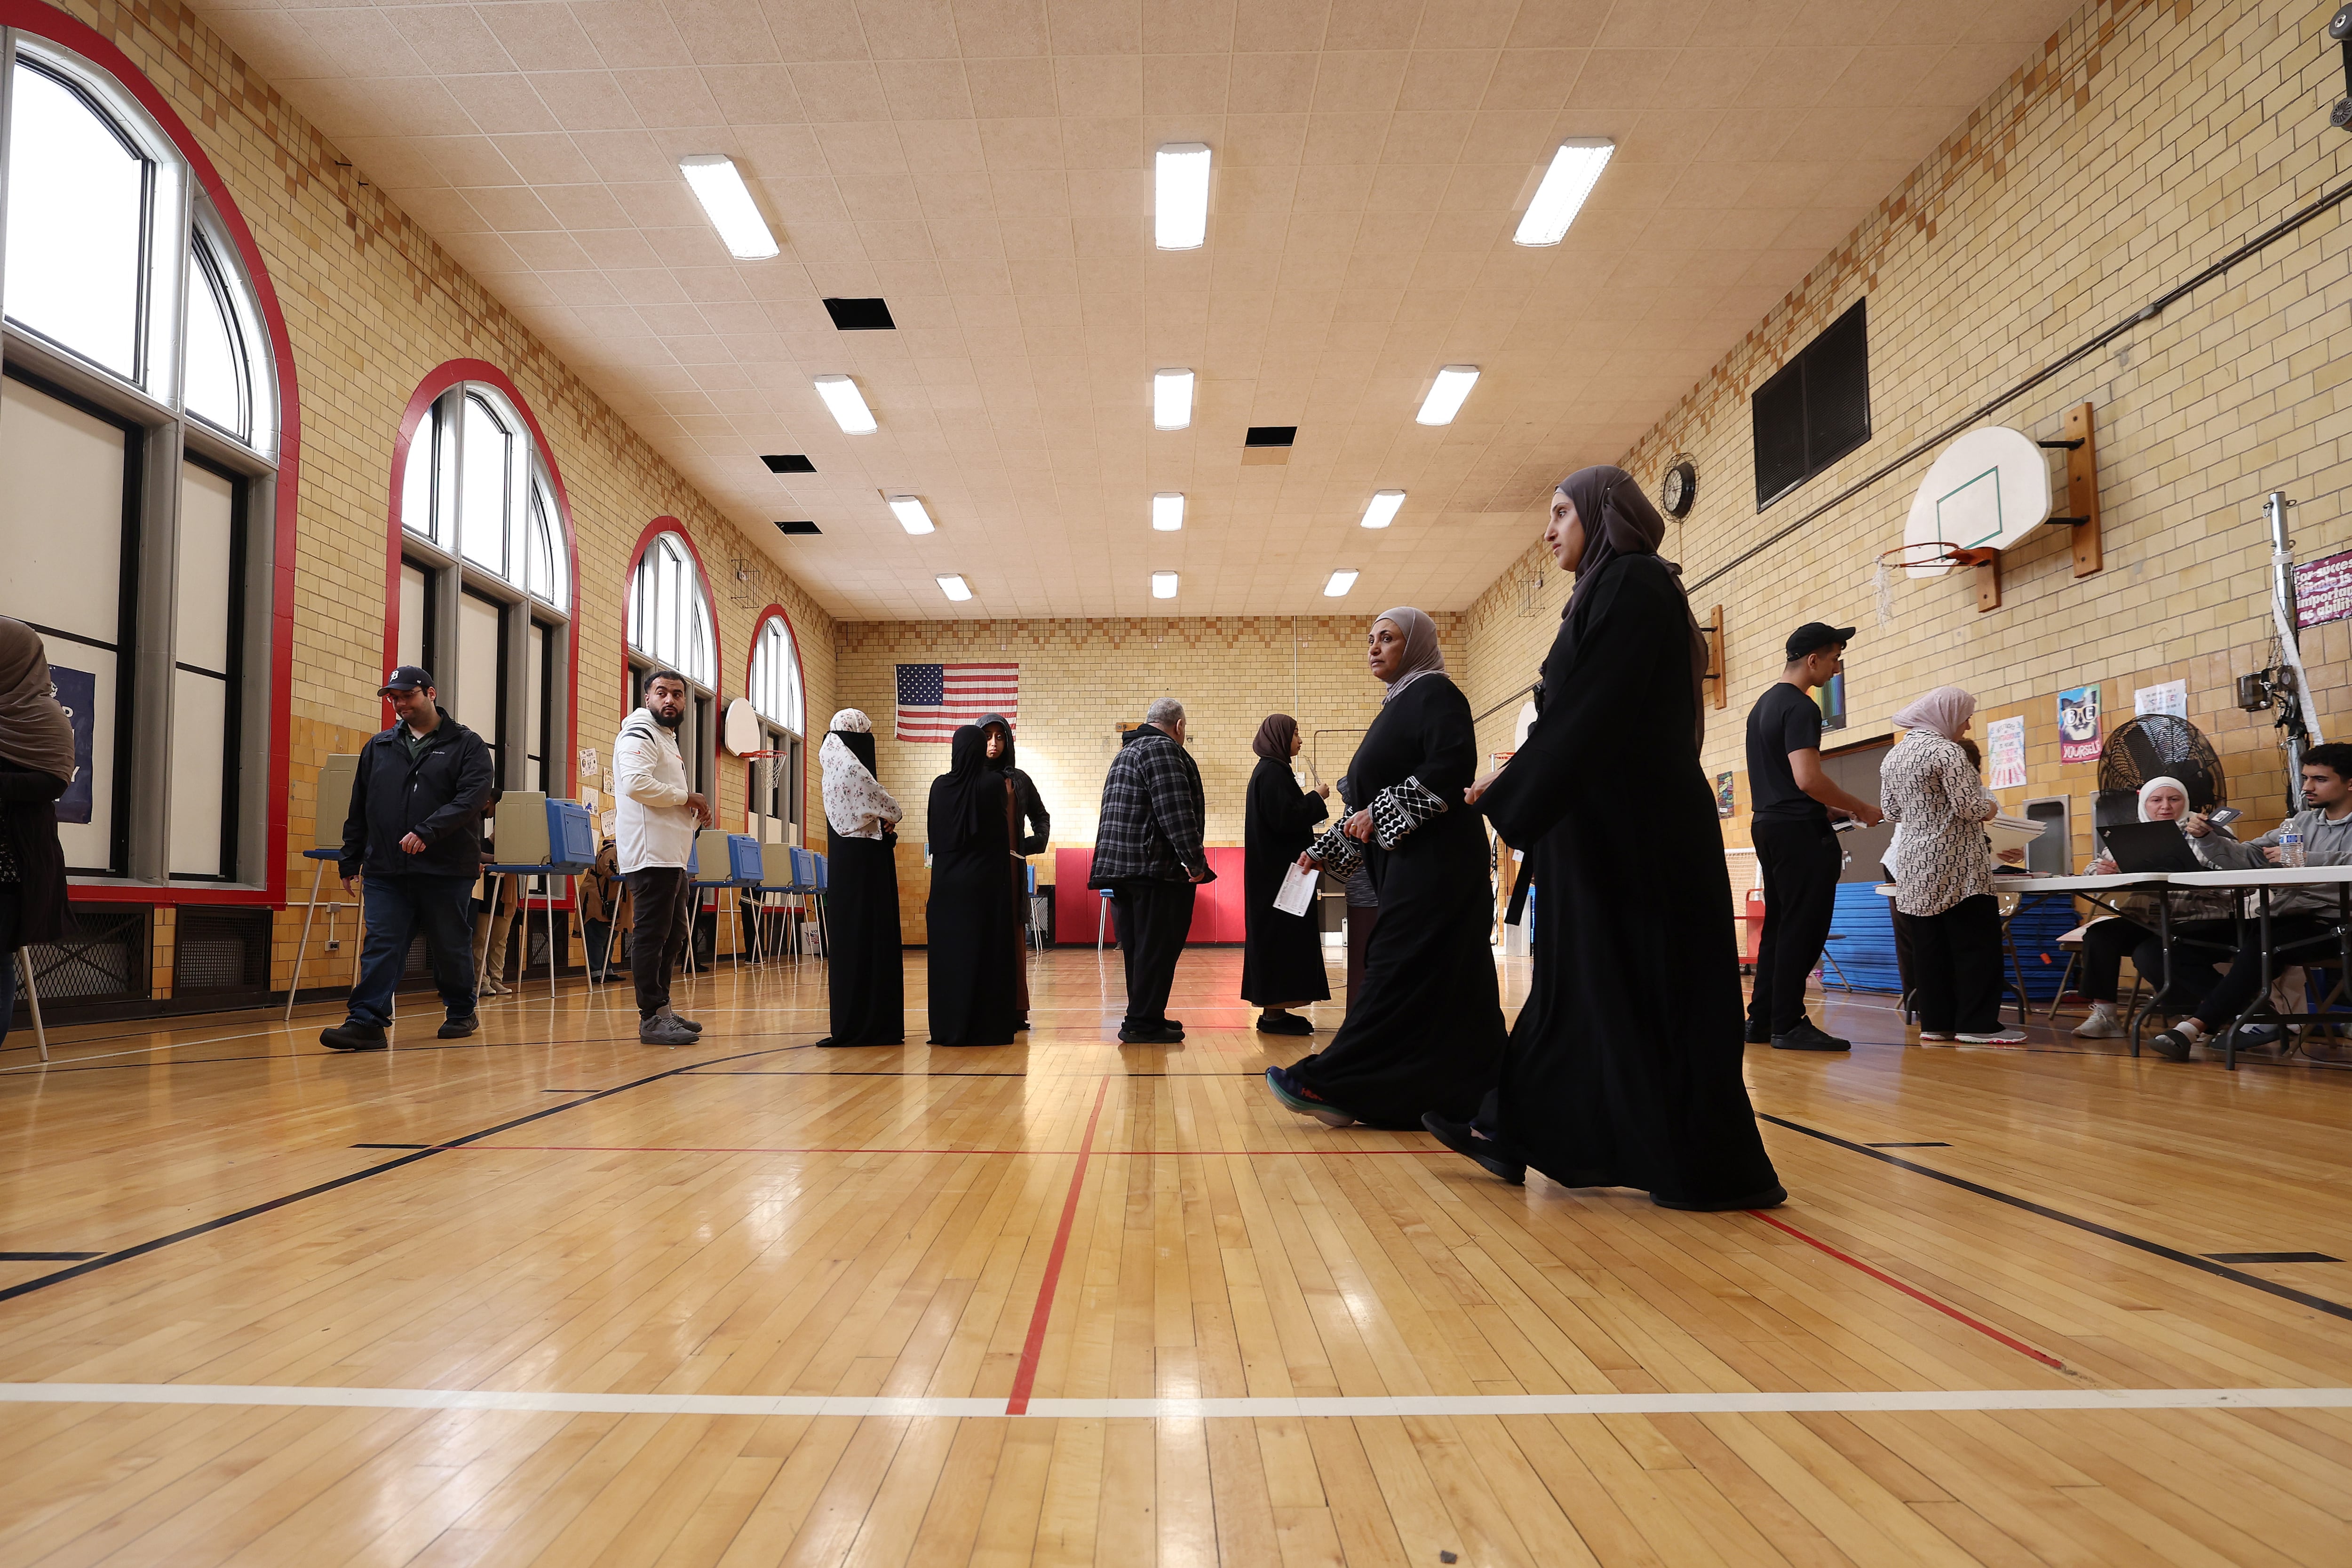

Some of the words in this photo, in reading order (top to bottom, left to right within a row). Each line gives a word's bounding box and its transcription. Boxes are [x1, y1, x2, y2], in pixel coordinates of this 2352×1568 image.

[2299, 609, 2314, 621] as
[2316, 597, 2352, 616] abilit
[2063, 740, 2101, 759] YOURSELF
